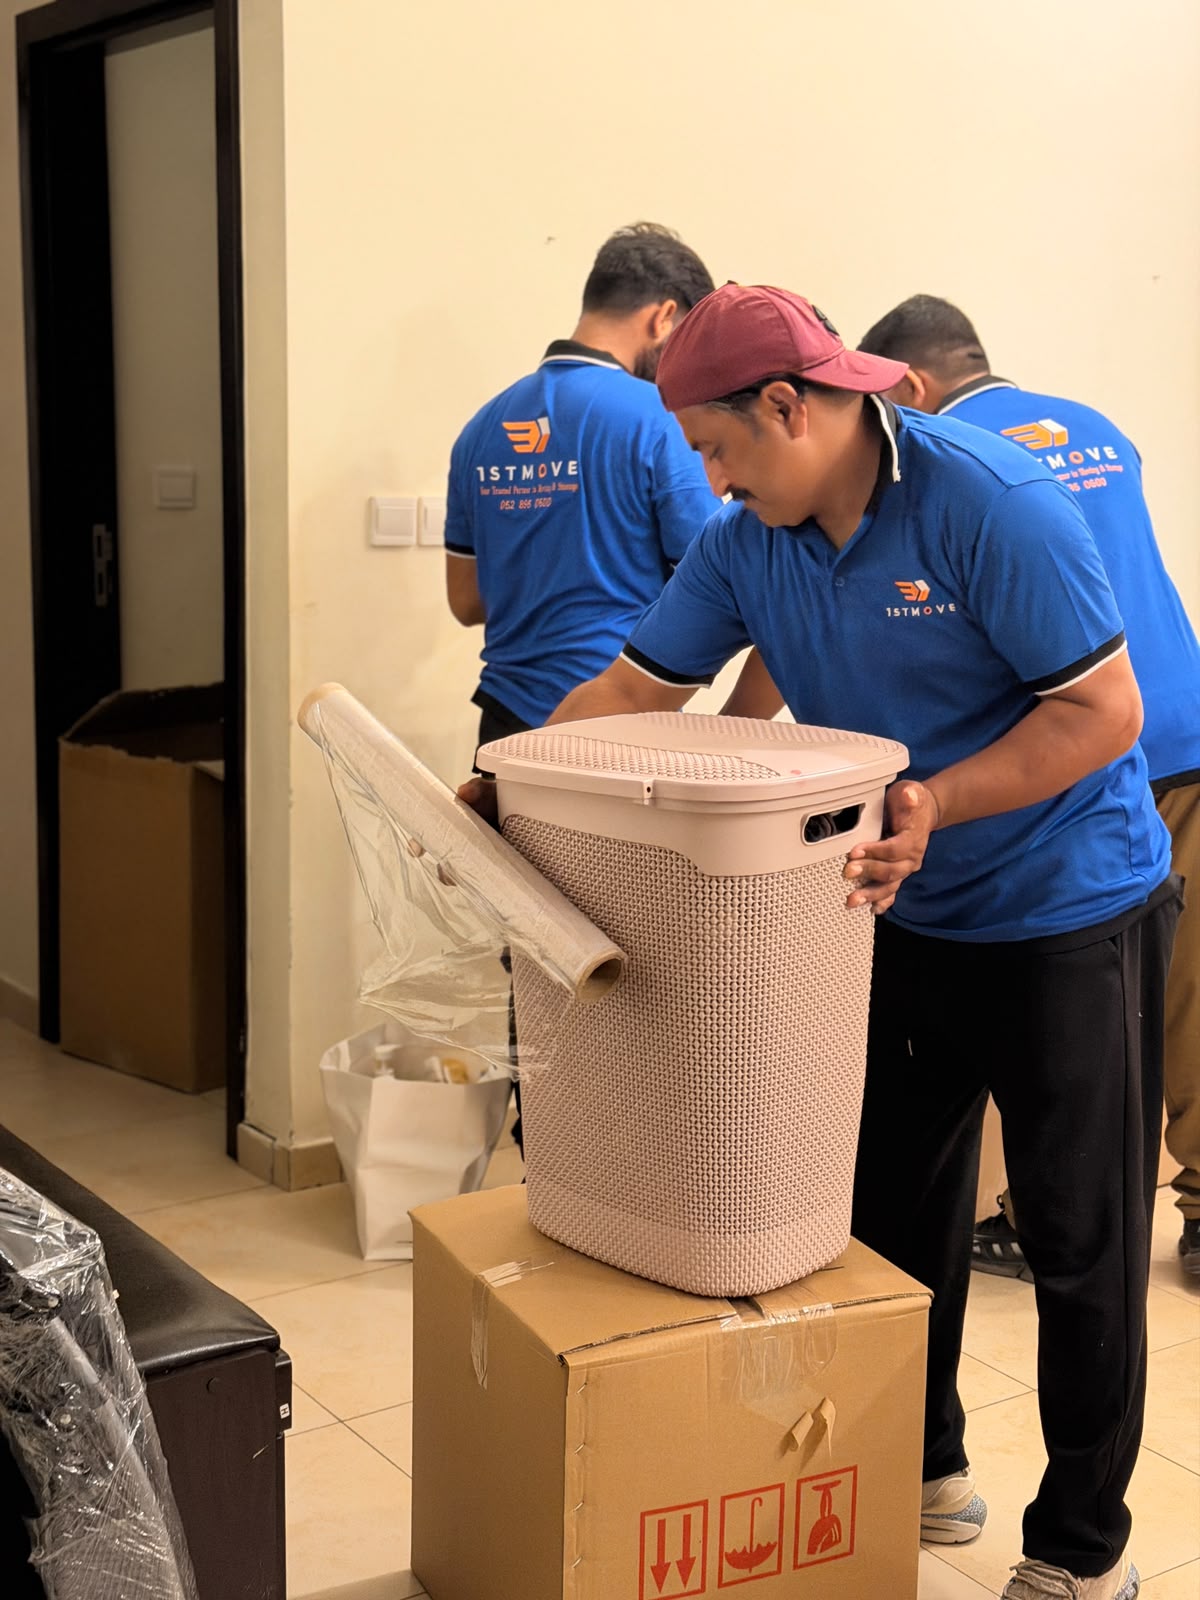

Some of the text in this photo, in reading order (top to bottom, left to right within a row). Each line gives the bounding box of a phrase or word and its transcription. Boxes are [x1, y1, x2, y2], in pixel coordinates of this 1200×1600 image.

[1037, 446, 1118, 470] MOVE
[476, 460, 578, 482] 1STMOVE
[886, 603, 956, 617] 1STMOVE
